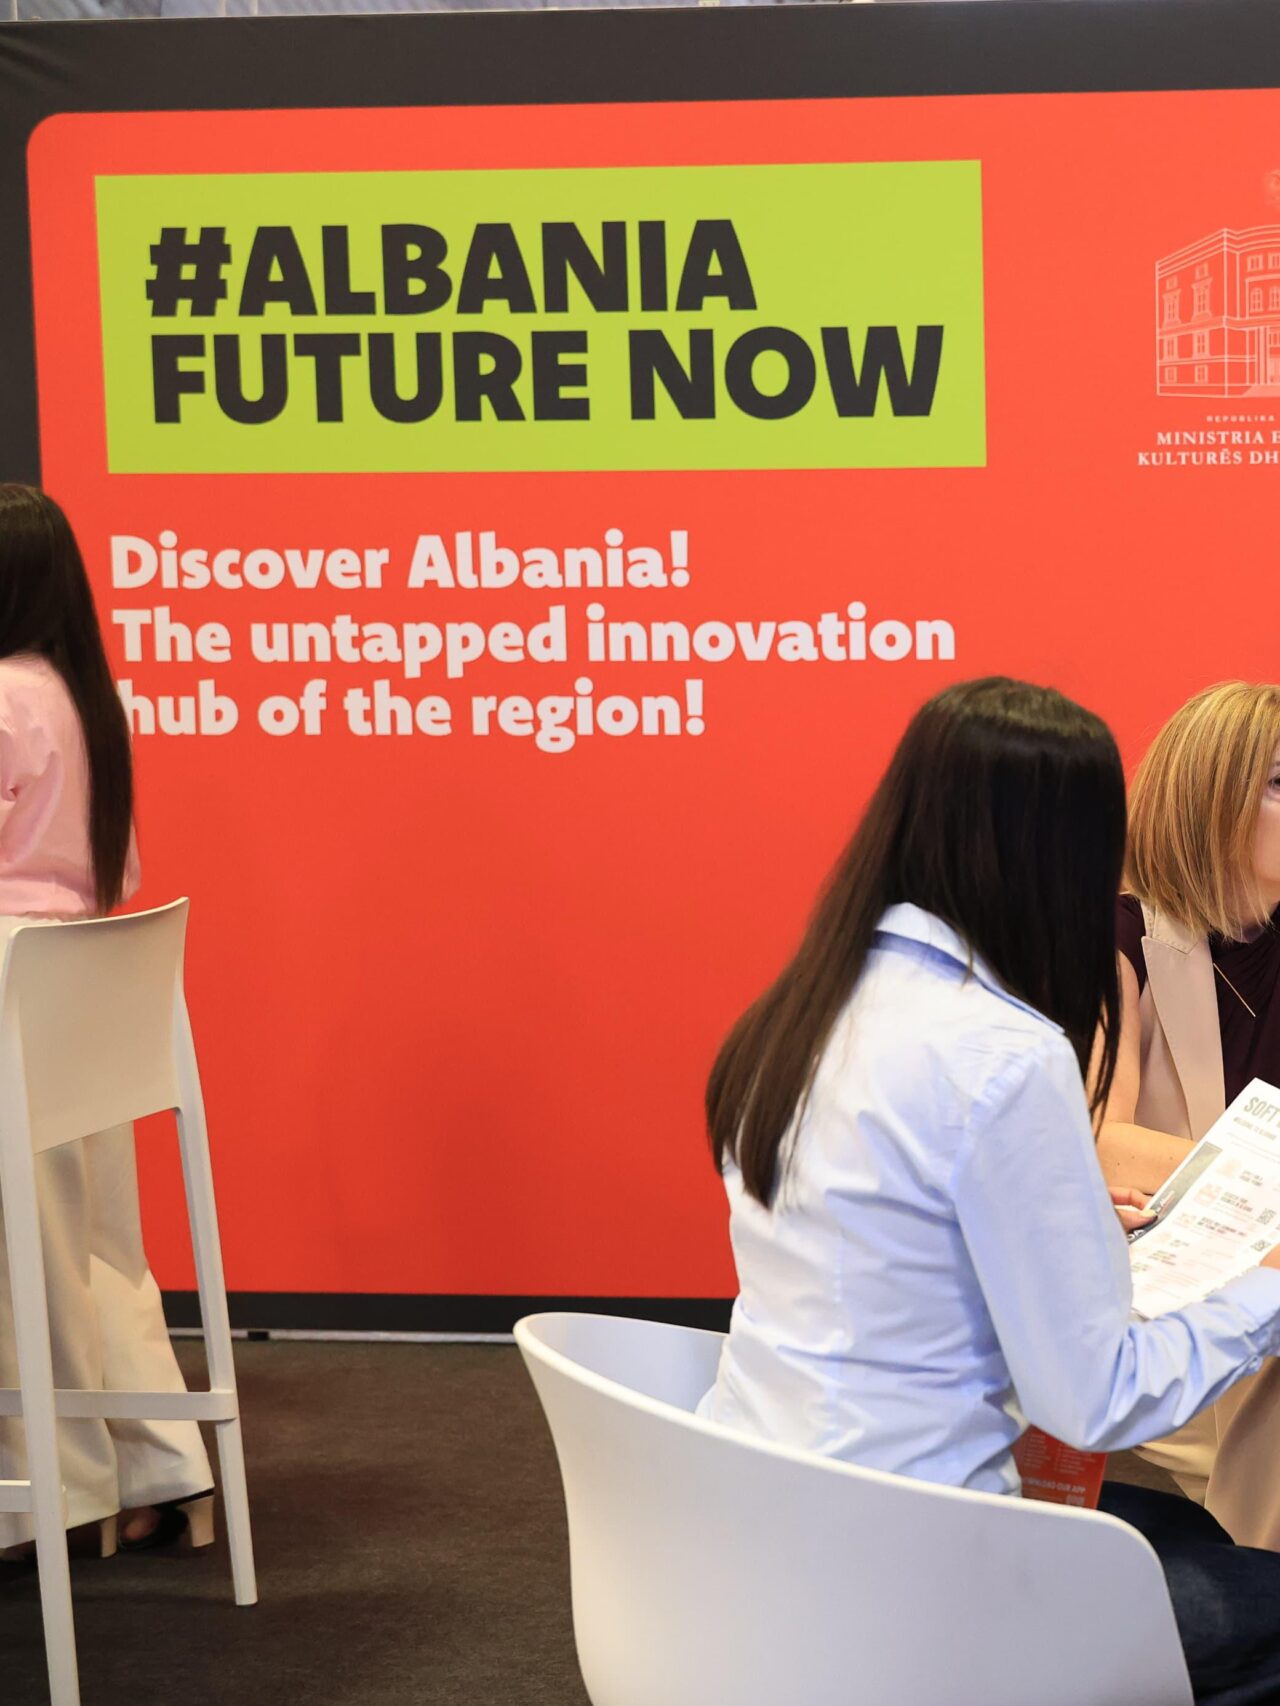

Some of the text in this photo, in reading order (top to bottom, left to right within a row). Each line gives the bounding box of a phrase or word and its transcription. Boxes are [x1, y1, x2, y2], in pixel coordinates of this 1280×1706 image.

[145, 219, 758, 317] #ALBANIA
[151, 325, 944, 425] FUTURE NOW
[1156, 430, 1265, 446] MINISTRIA
[1206, 414, 1275, 423] REPUBLIKA
[1137, 448, 1243, 466] KULTURËS
[111, 528, 690, 589] Discover Albania!
[112, 601, 956, 679] The untapped innovation
[116, 677, 705, 753] hub of the region!
